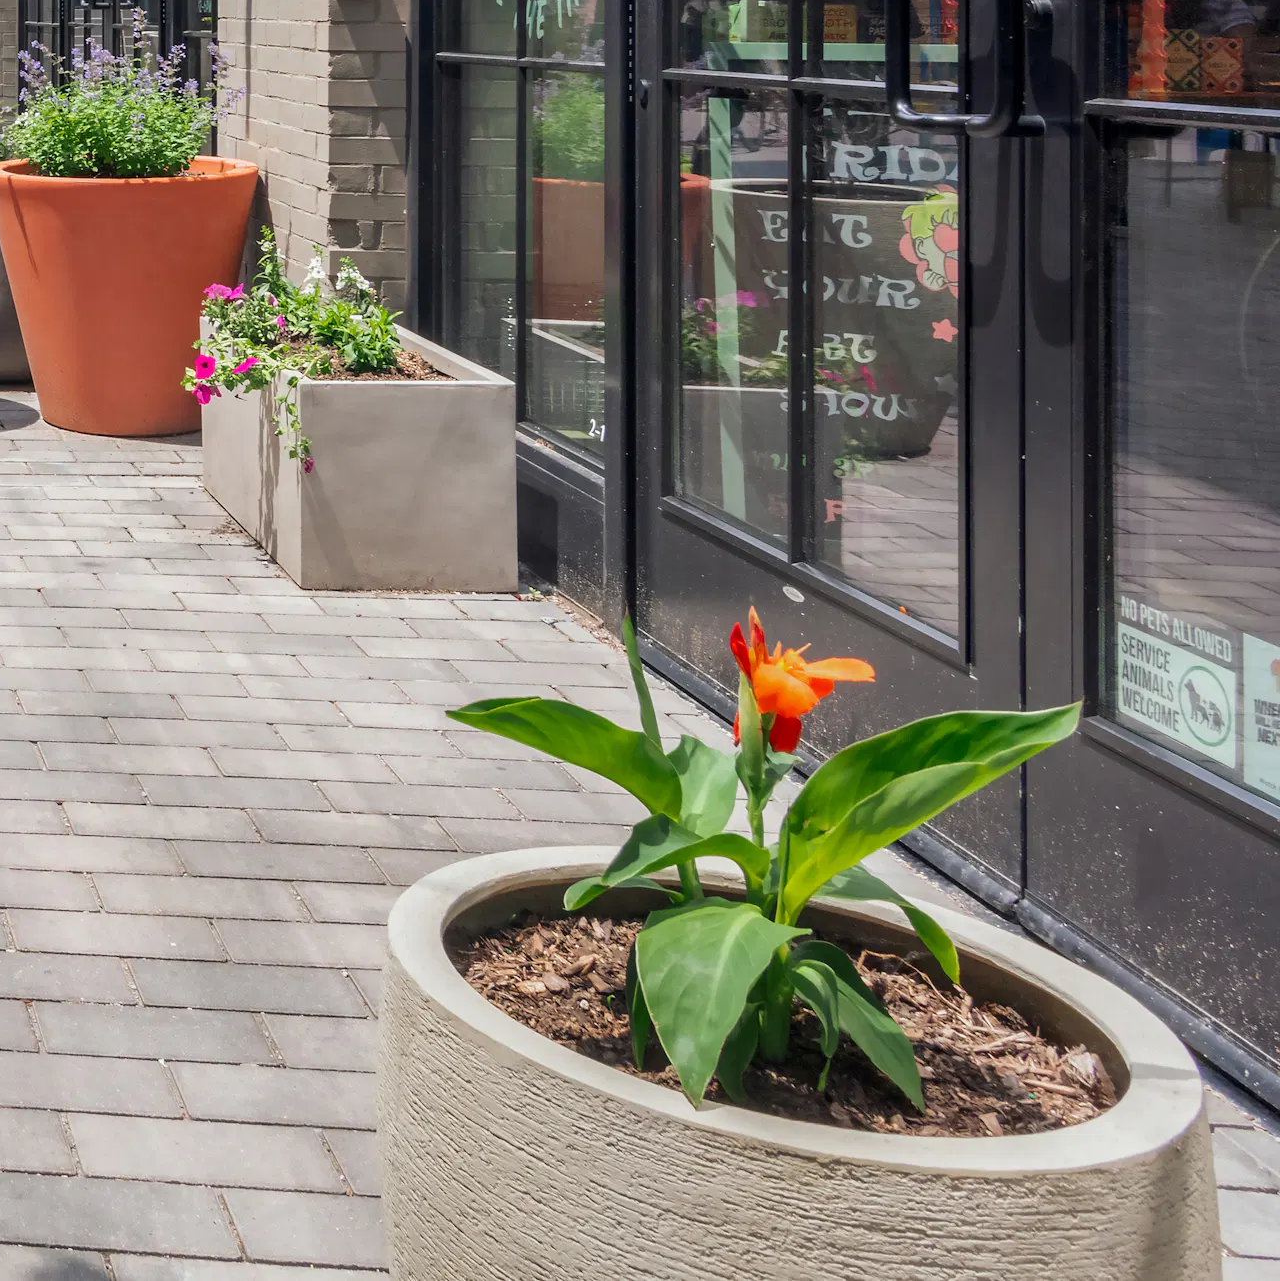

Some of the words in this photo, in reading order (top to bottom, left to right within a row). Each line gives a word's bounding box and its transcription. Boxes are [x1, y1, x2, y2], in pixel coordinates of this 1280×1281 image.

[1121, 595, 1138, 622] NO
[1140, 602, 1170, 636] PETS
[1172, 618, 1233, 663] ALLOWED
[1121, 632, 1171, 674] SERVICE
[1122, 659, 1174, 703] ANIMALS
[1122, 685, 1180, 733] WELCOME
